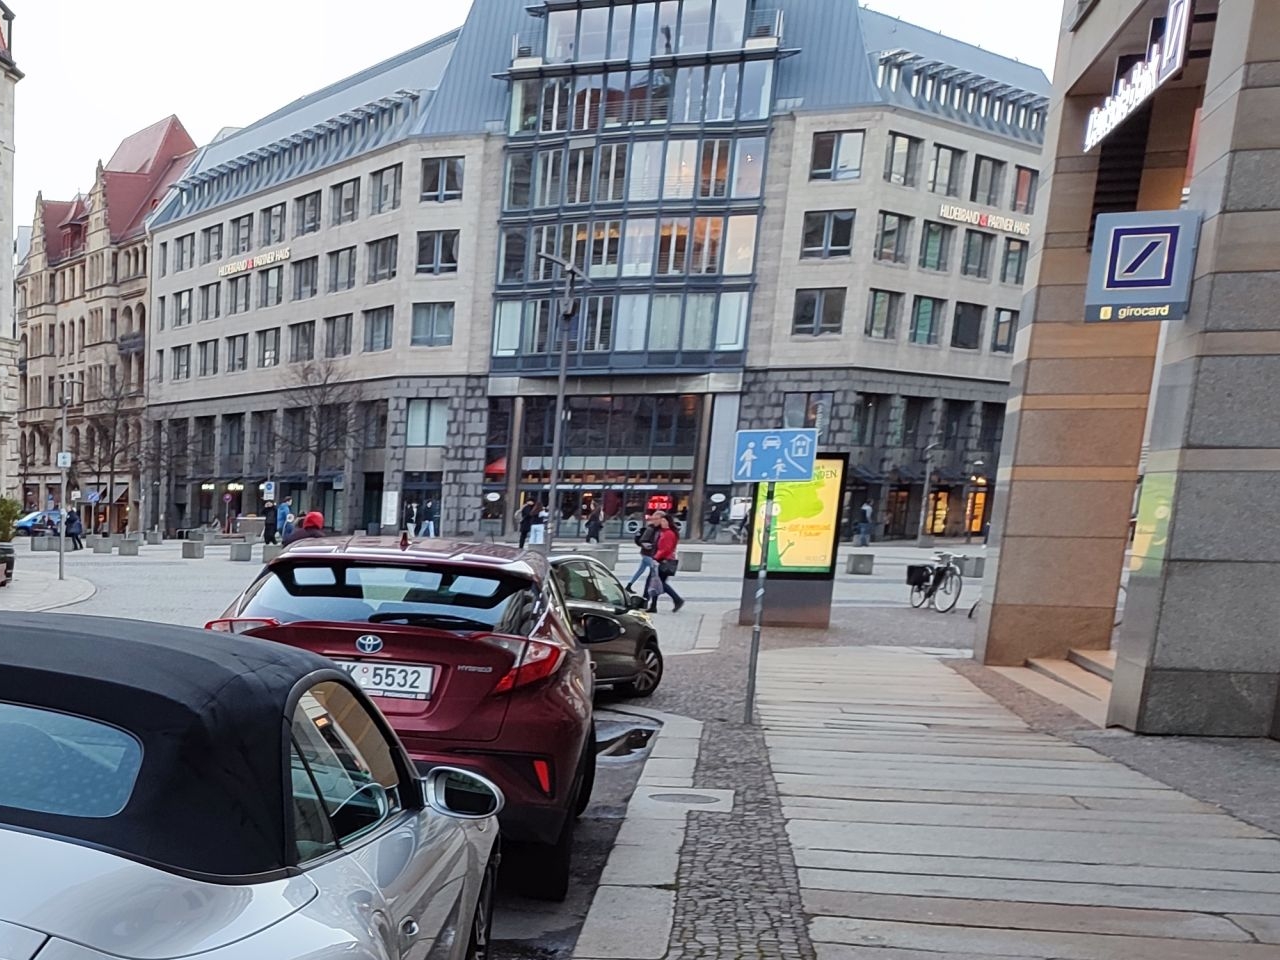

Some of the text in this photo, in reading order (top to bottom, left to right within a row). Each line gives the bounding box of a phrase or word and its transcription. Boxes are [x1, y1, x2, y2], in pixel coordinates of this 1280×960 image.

[939, 204, 980, 224] HILDEBRAND
[987, 214, 1014, 232] PARTNER
[1013, 221, 1030, 236] HAUS
[1118, 304, 1169, 319] girocard
[372, 666, 421, 689] 5532
